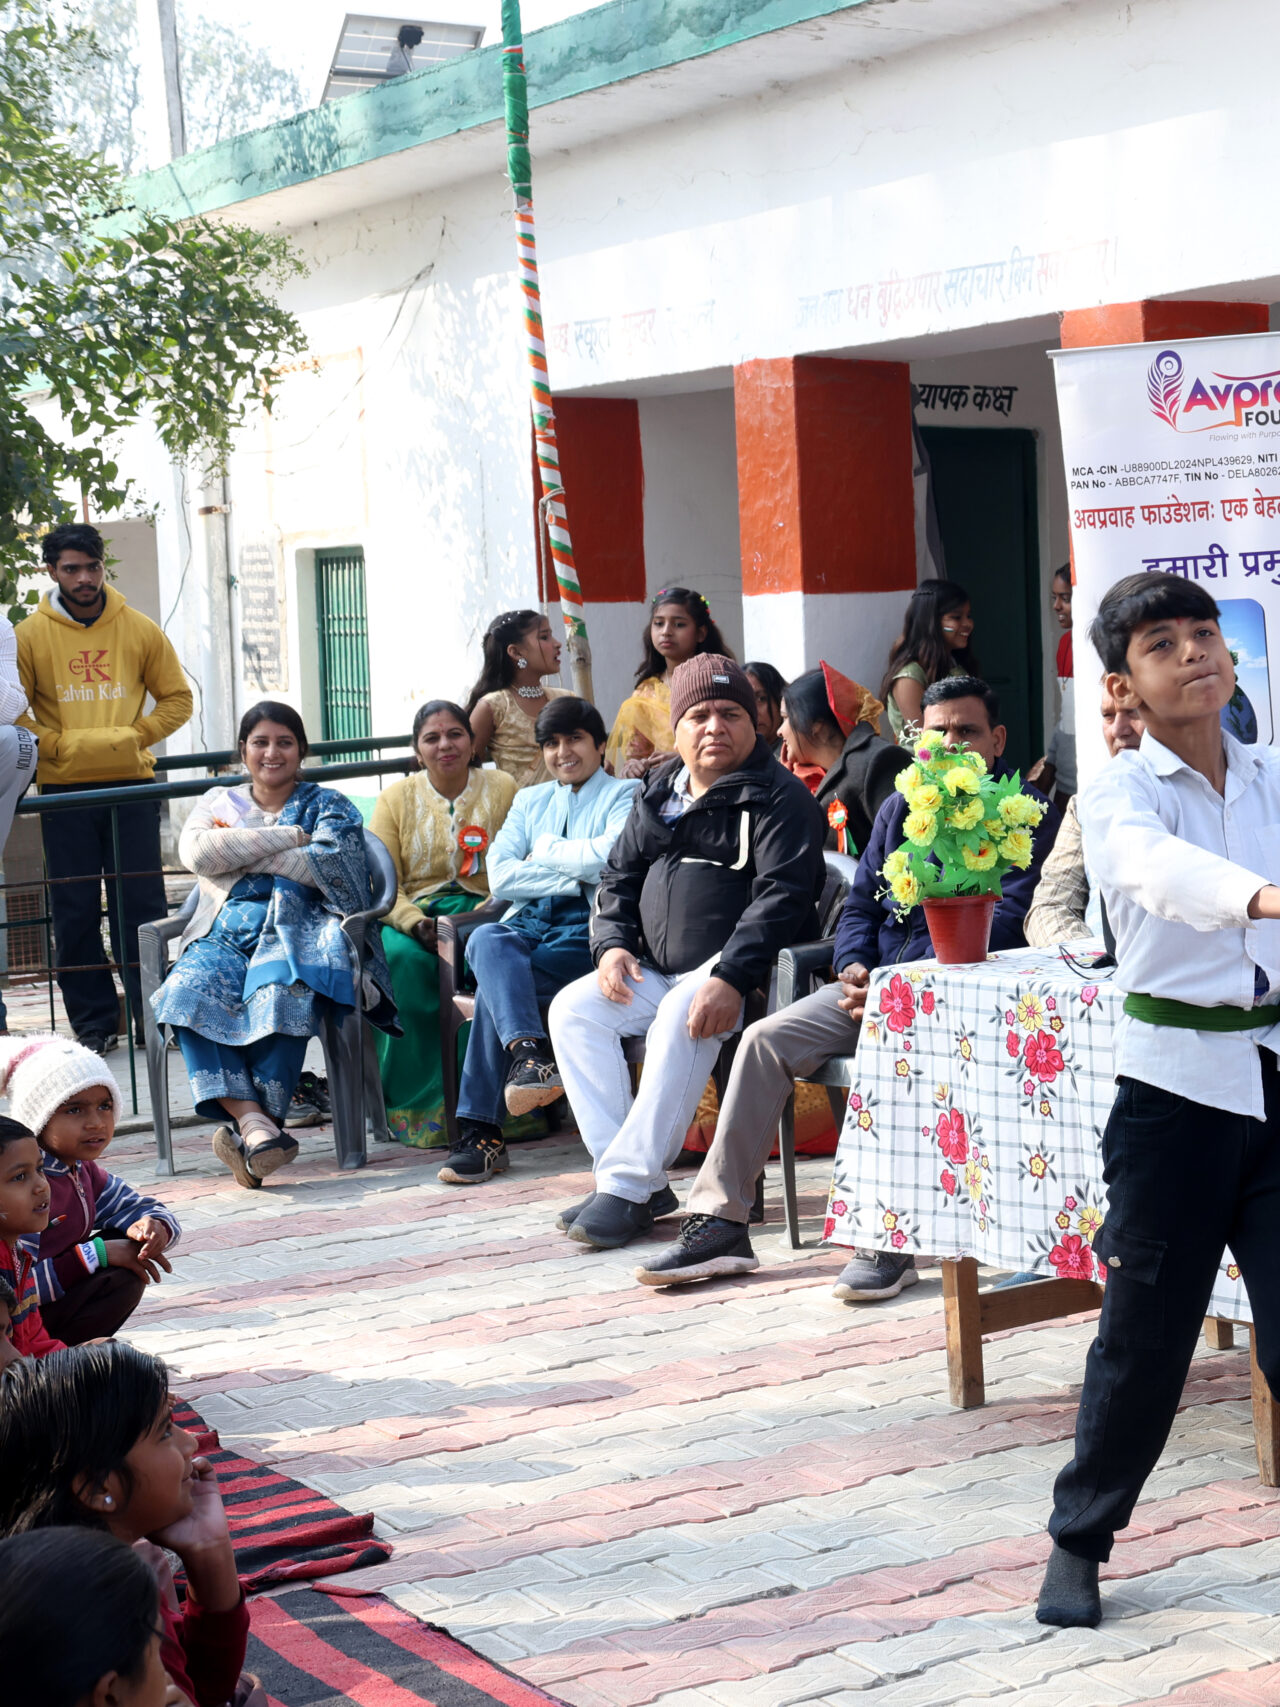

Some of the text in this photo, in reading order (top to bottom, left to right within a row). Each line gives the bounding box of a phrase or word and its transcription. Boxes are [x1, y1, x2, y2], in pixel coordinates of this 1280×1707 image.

[973, 385, 1018, 418] कक्ष
[1209, 432, 1239, 444] Flowing
[1241, 430, 1256, 440] with
[1072, 466, 1094, 477] MCA
[1258, 453, 1278, 465] NITI
[1071, 479, 1089, 491] PAN
[1092, 478, 1106, 488] No
[1185, 472, 1203, 483] TIN
[1205, 471, 1219, 482] No
[1074, 506, 1136, 529] अवप्रवाह
[1221, 498, 1249, 522] एक
[1142, 543, 1229, 581] हमारी
